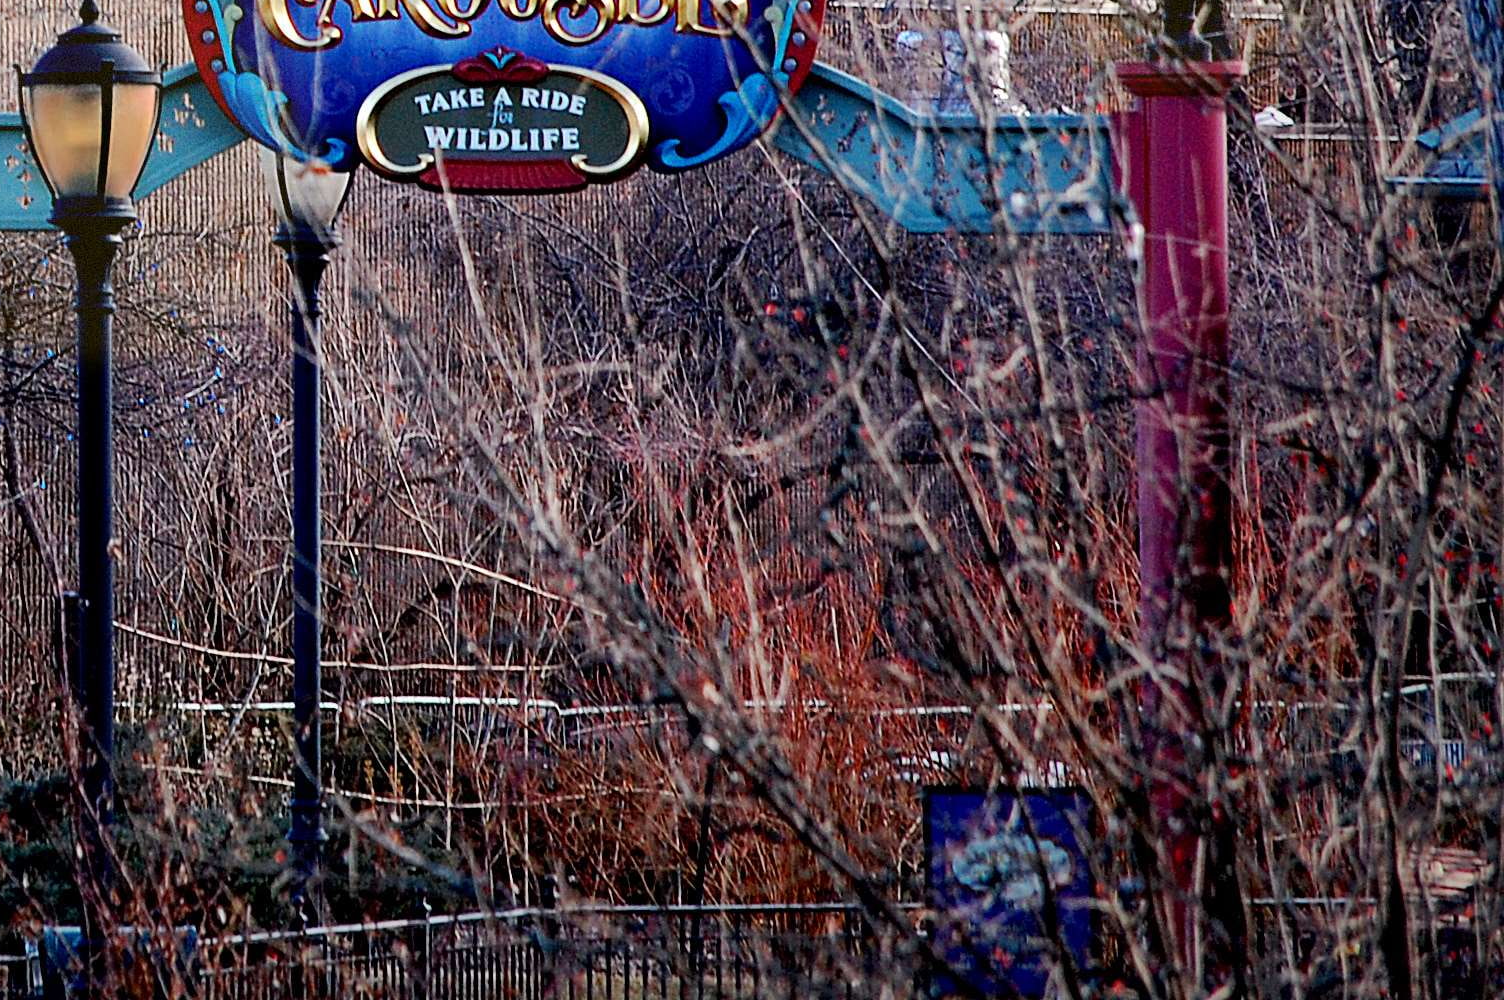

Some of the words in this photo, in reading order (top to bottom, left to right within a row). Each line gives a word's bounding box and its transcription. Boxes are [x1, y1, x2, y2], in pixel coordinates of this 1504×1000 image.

[414, 86, 485, 116] TAKE
[493, 86, 513, 106] A
[521, 87, 587, 116] RIDE
[423, 125, 581, 152] WILDLIFE
